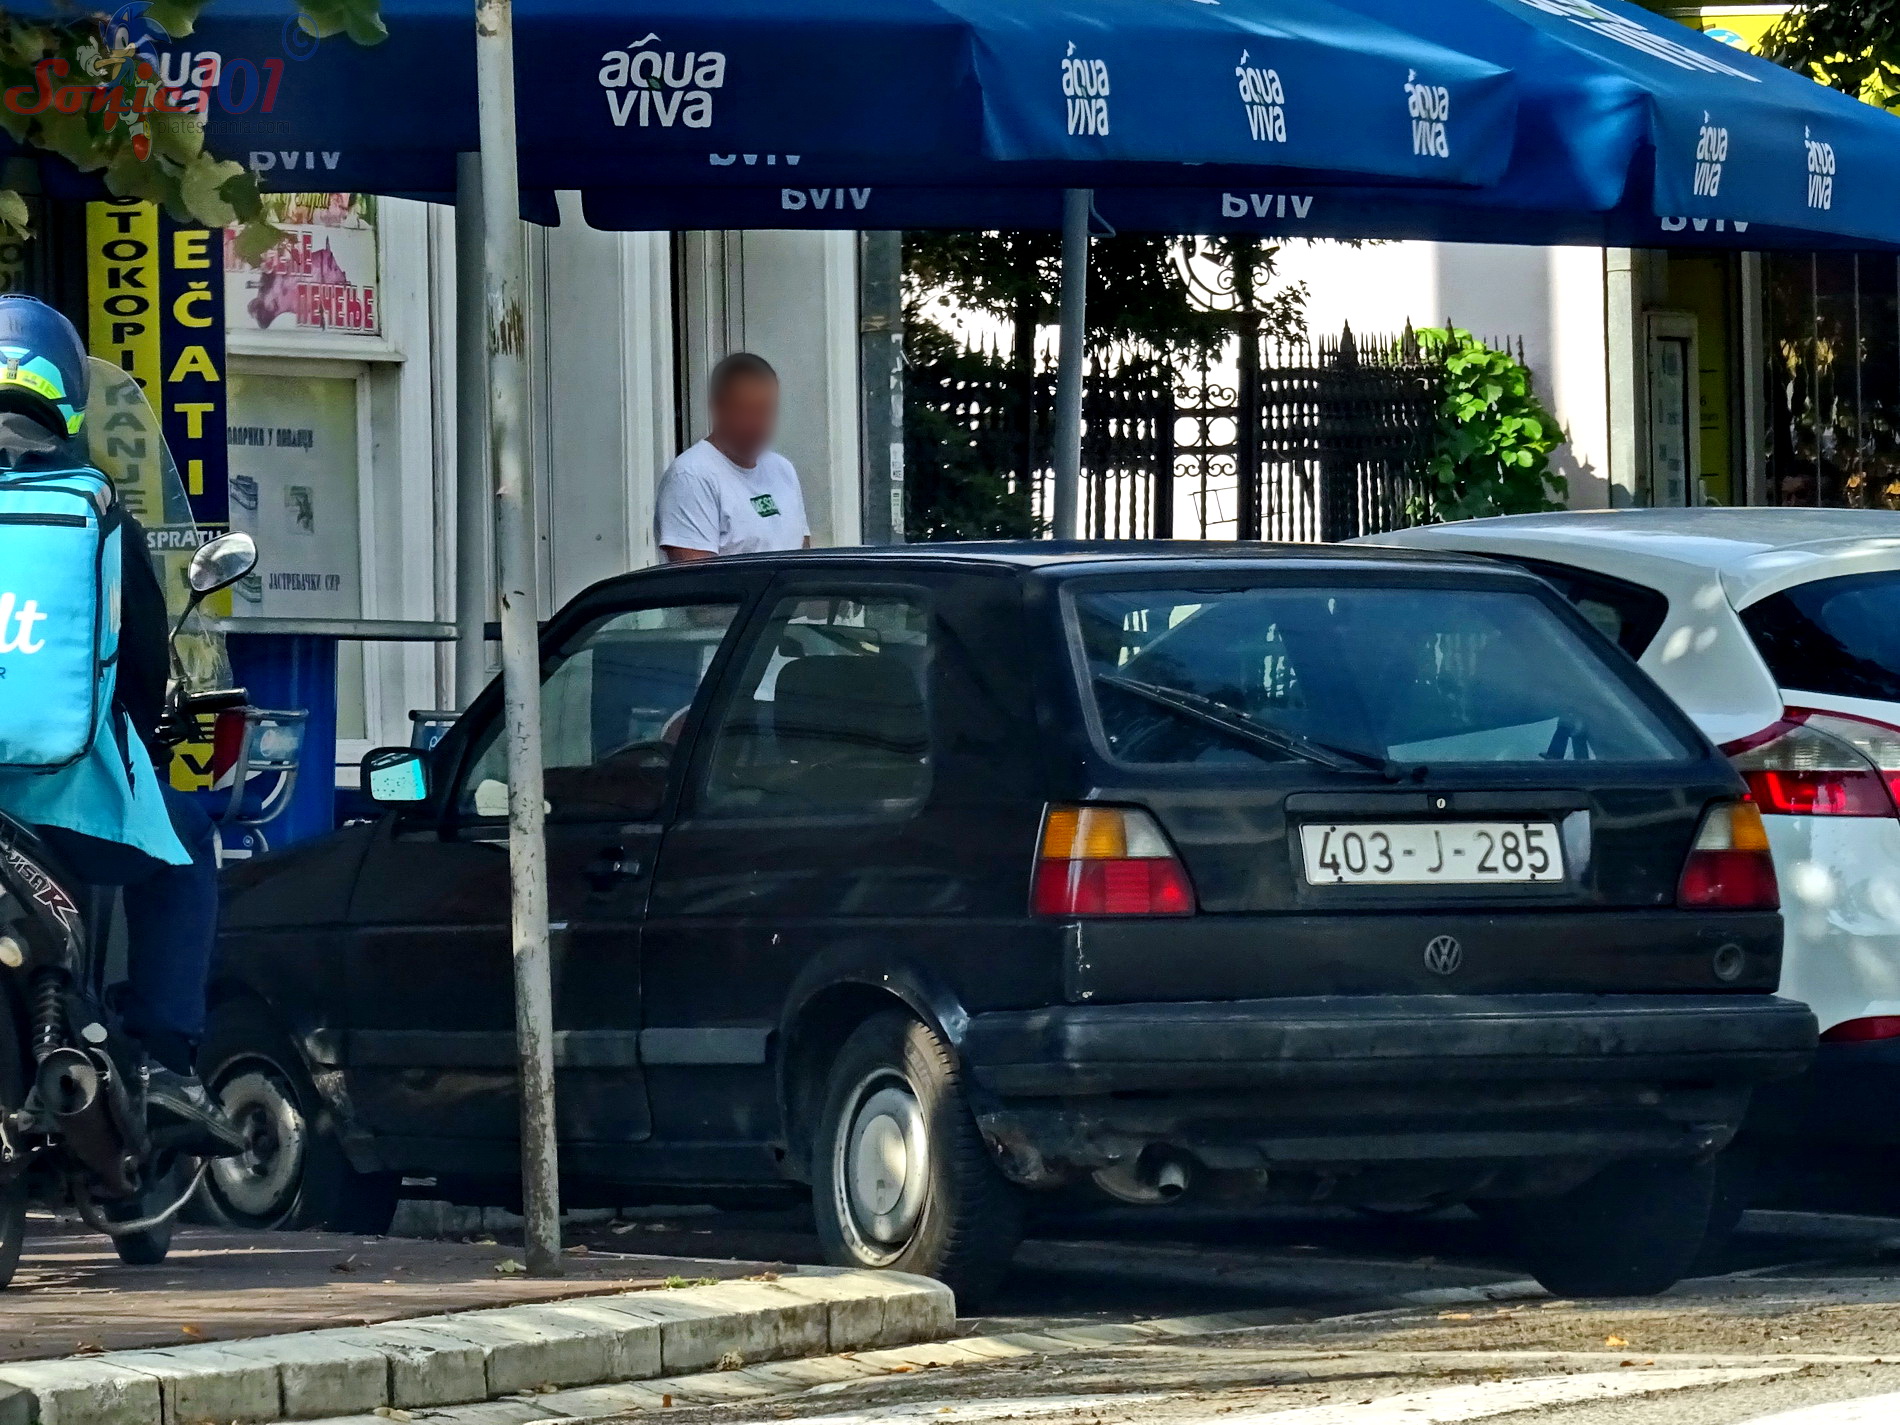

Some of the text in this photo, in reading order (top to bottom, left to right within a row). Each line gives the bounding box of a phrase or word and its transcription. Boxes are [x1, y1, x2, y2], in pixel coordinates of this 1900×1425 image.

[161, 51, 221, 87] ua
[599, 51, 726, 88] aqua
[1062, 59, 1109, 96] aqua
[1235, 66, 1284, 104] aqua
[606, 90, 712, 128] viva
[1067, 99, 1109, 136] viva
[1404, 82, 1449, 120] aqua
[1246, 105, 1286, 142] viva
[1413, 120, 1449, 158] viva
[1697, 126, 1728, 162] aqua
[1805, 140, 1835, 175] aqua
[1694, 162, 1721, 197] viva
[1808, 174, 1832, 210] viva
[168, 230, 220, 495] EČATI
[1318, 829, 1550, 876] 403-J-285
